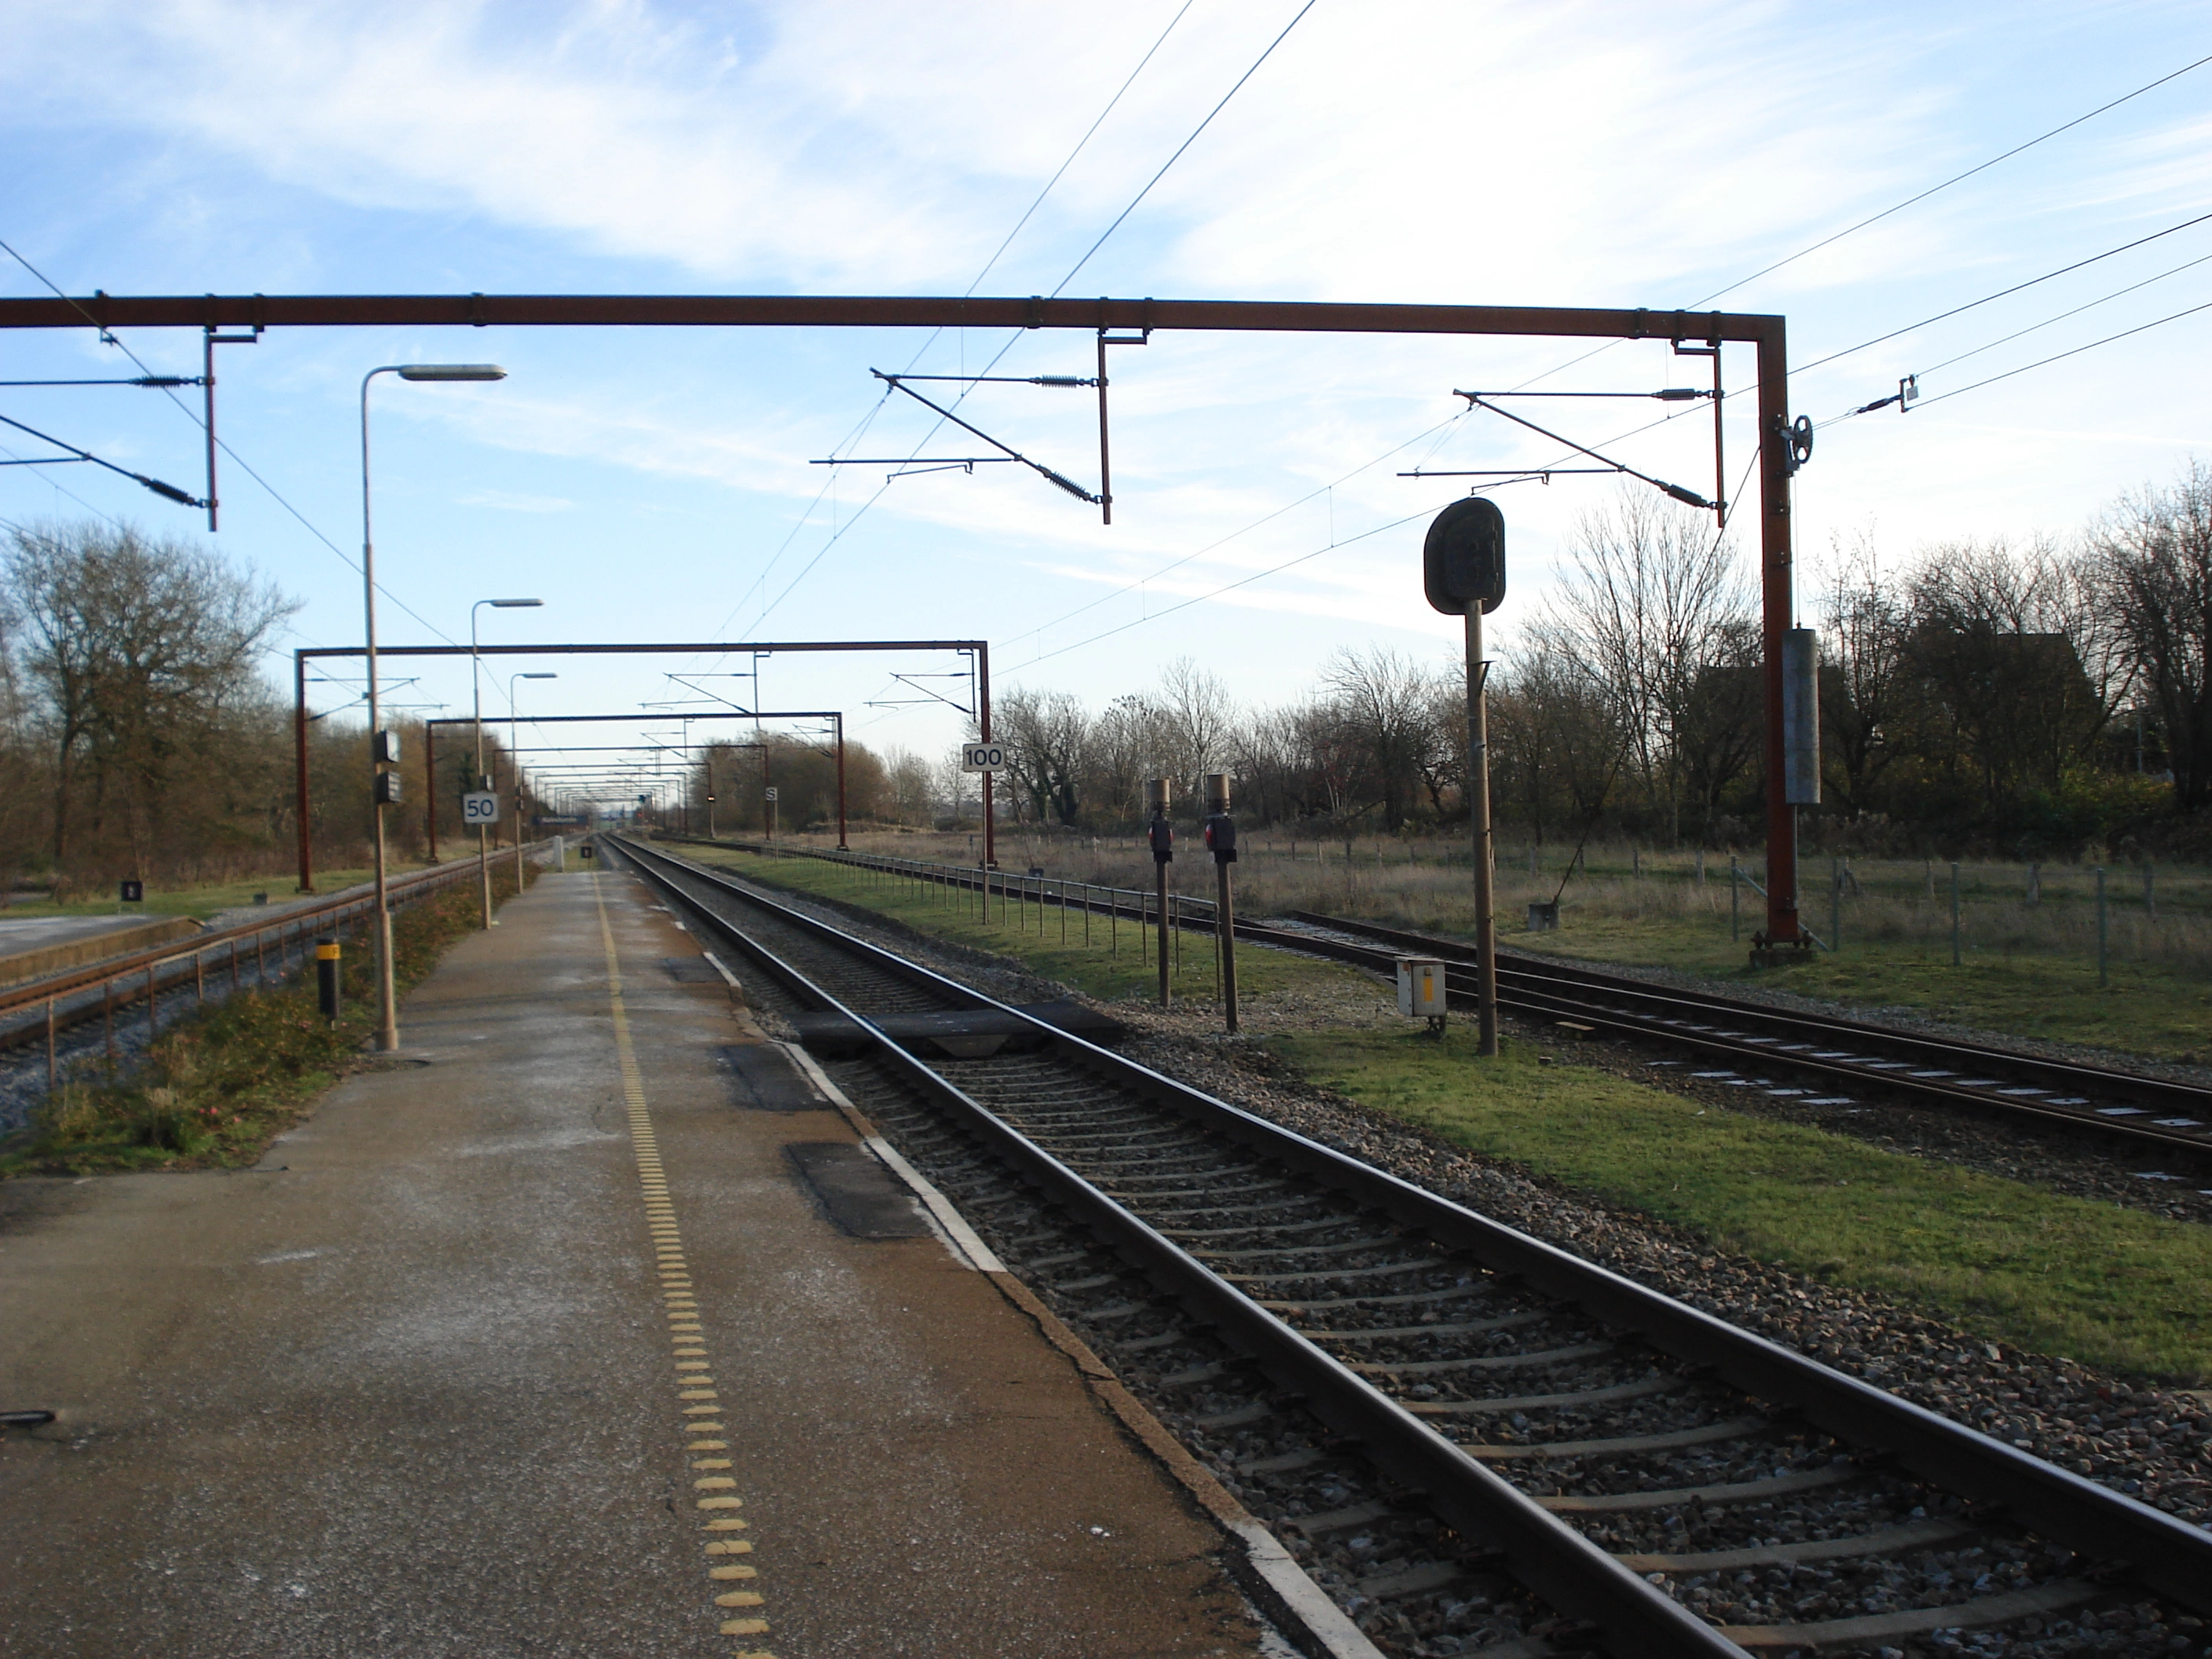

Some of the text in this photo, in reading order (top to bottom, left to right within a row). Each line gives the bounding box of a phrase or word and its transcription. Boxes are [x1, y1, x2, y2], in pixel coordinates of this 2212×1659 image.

[966, 749, 1002, 766] 100
[767, 789, 775, 799] S
[467, 799, 493, 817] 50
